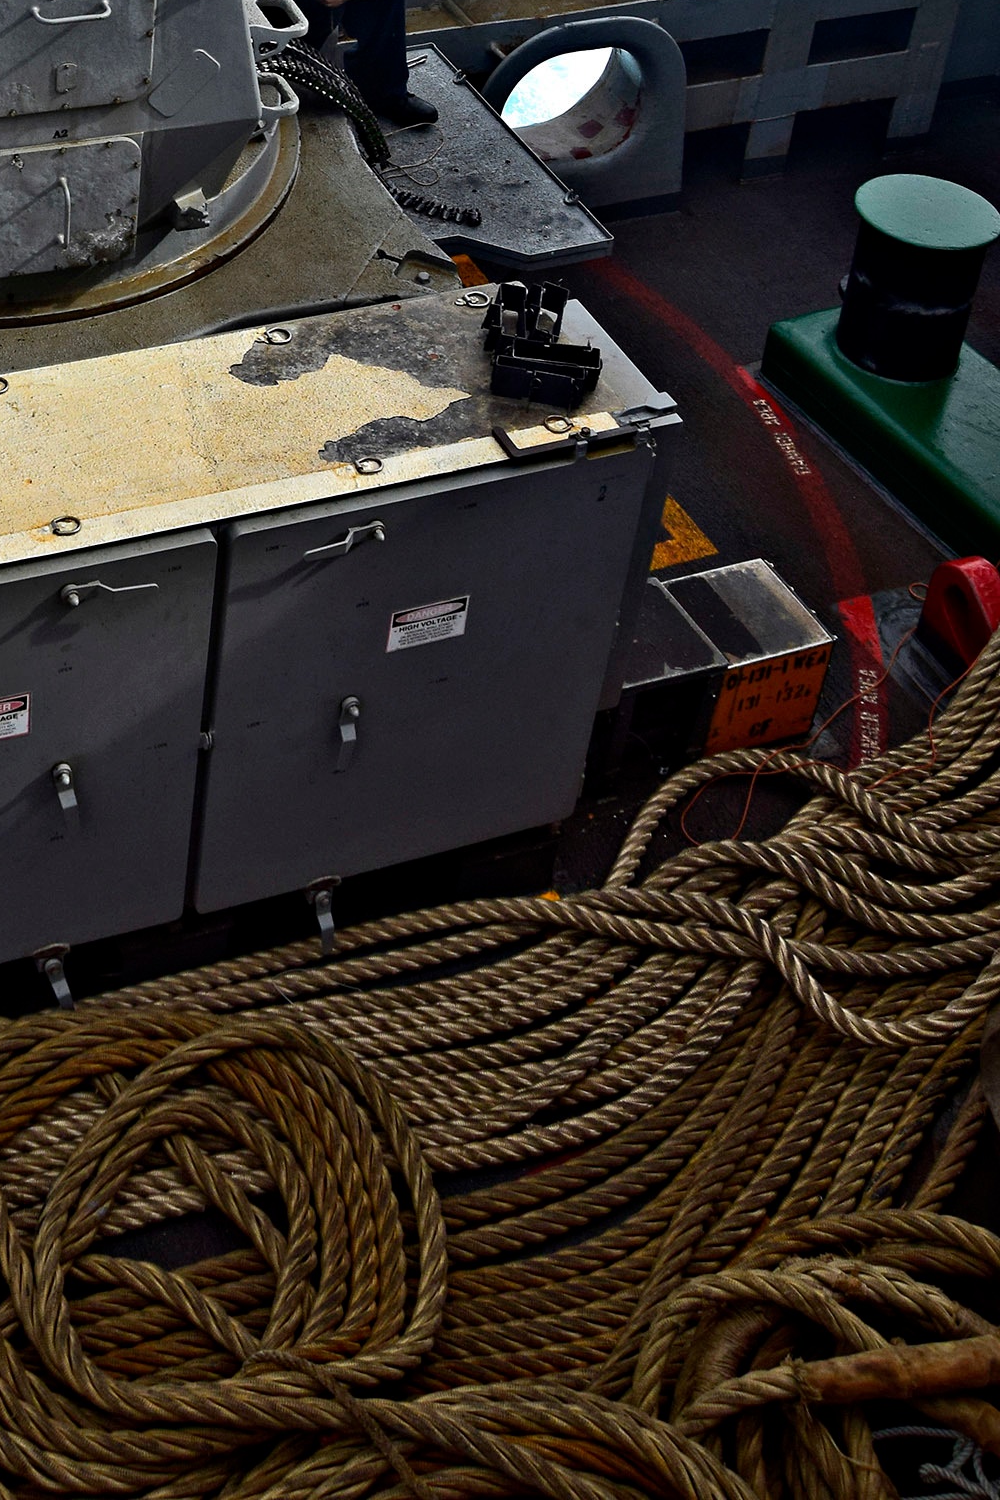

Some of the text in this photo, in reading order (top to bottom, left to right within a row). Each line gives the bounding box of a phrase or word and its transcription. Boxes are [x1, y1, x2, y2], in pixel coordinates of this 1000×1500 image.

[53, 129, 68, 139] A2
[406, 603, 453, 621] DANGER
[398, 623, 420, 633] HIGH
[421, 614, 458, 628] VOLTAGE
